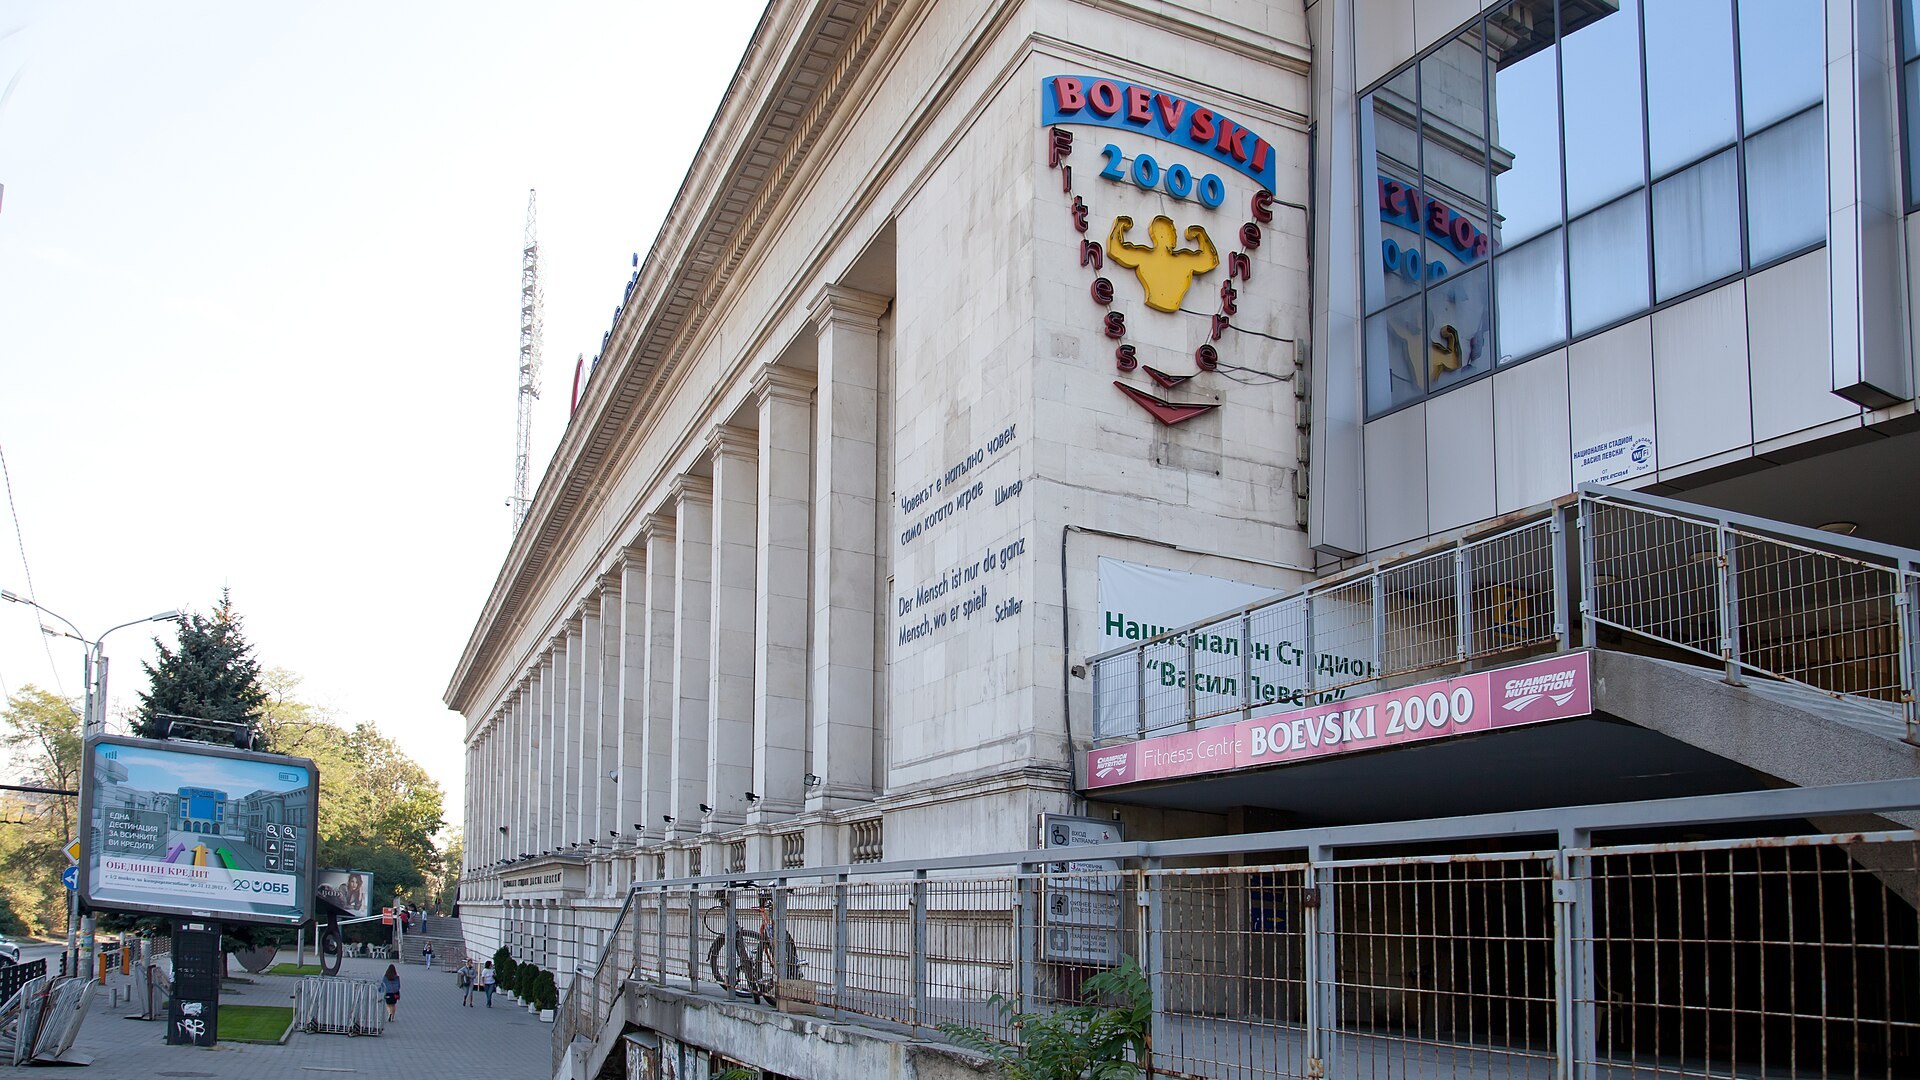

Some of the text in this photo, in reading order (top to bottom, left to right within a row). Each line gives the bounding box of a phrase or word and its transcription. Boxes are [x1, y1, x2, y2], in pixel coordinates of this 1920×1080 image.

[1053, 76, 1271, 173] BOEVSKI
[1100, 143, 1226, 210] 2000
[1574, 435, 1633, 460] НАЦИОНАЛЕН СТАДИОН
[901, 423, 1017, 515] Човекът е напълно човек
[994, 480, 1023, 506] Шилер
[901, 481, 984, 546] само когато играе
[899, 538, 1025, 617] Der Mensch ist nur da ganz
[899, 585, 987, 647] Mensch, wo er spielt
[994, 597, 1023, 623] Schiller
[1277, 641, 1381, 678] Стдион
[1505, 669, 1576, 690] CHAMPION
[1505, 679, 1574, 699] NUTRITION
[1144, 687, 1474, 769] Fitness Centre BOEVSKI 2000
[1096, 752, 1128, 764] CHAMPION
[1096, 760, 1127, 769] NUTRITION
[109, 812, 130, 820] ЕДНА
[109, 821, 158, 832] ДЕСТИНАЦИЯ
[120, 831, 158, 841] ВСИЧКИТЕ
[120, 841, 155, 850] КРЕДИТИ
[1071, 837, 1099, 845] ENTRANCE
[106, 861, 210, 878] ОБЕДИНЕН КРЕДИТ
[233, 879, 250, 891] 20
[263, 882, 289, 893] ОББ
